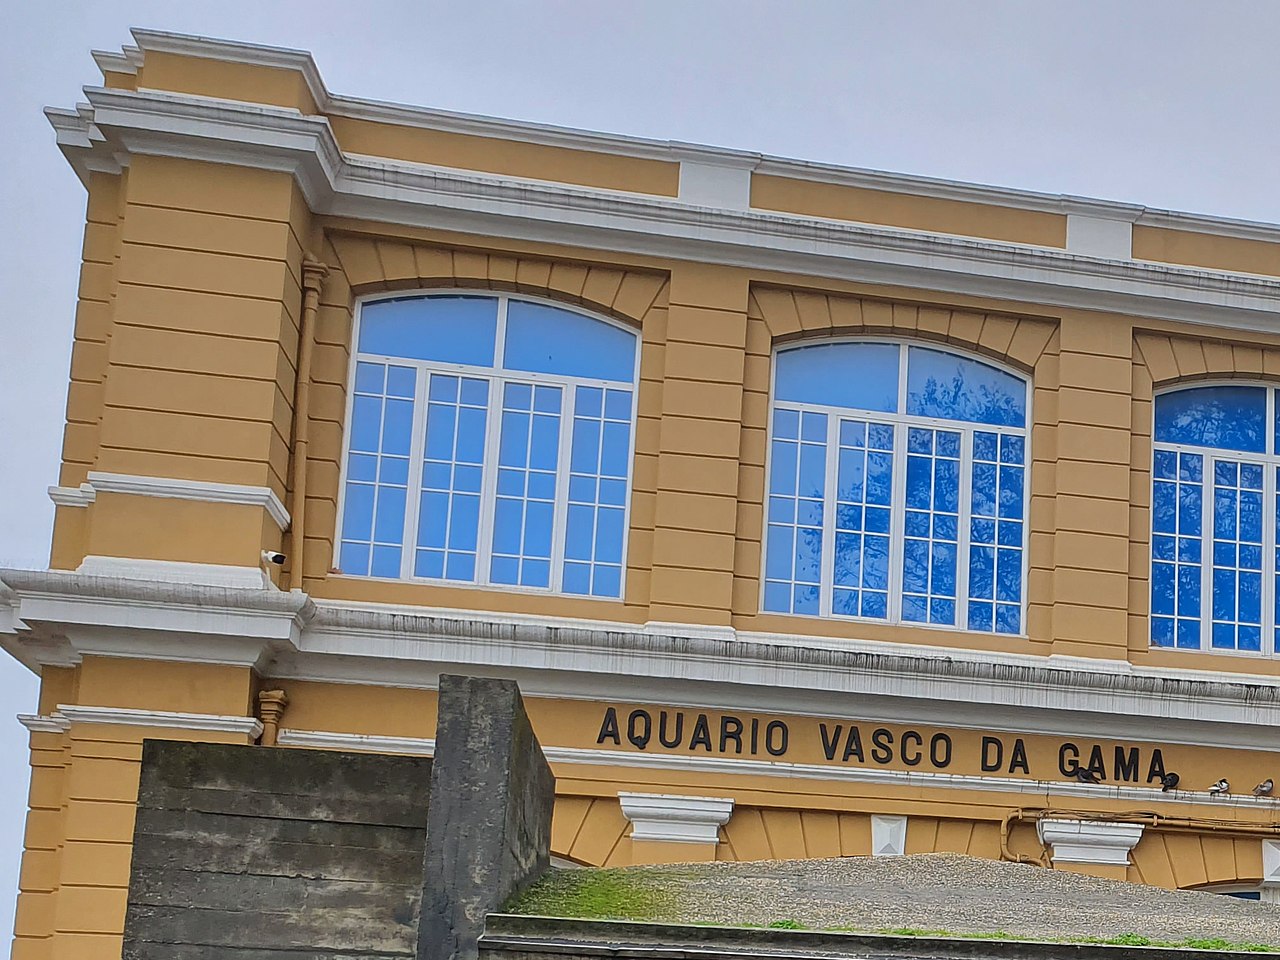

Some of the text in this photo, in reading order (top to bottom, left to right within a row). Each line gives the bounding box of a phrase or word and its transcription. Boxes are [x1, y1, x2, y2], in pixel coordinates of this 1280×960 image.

[596, 706, 1167, 784] AQUARIO VASCO DA GAMA
